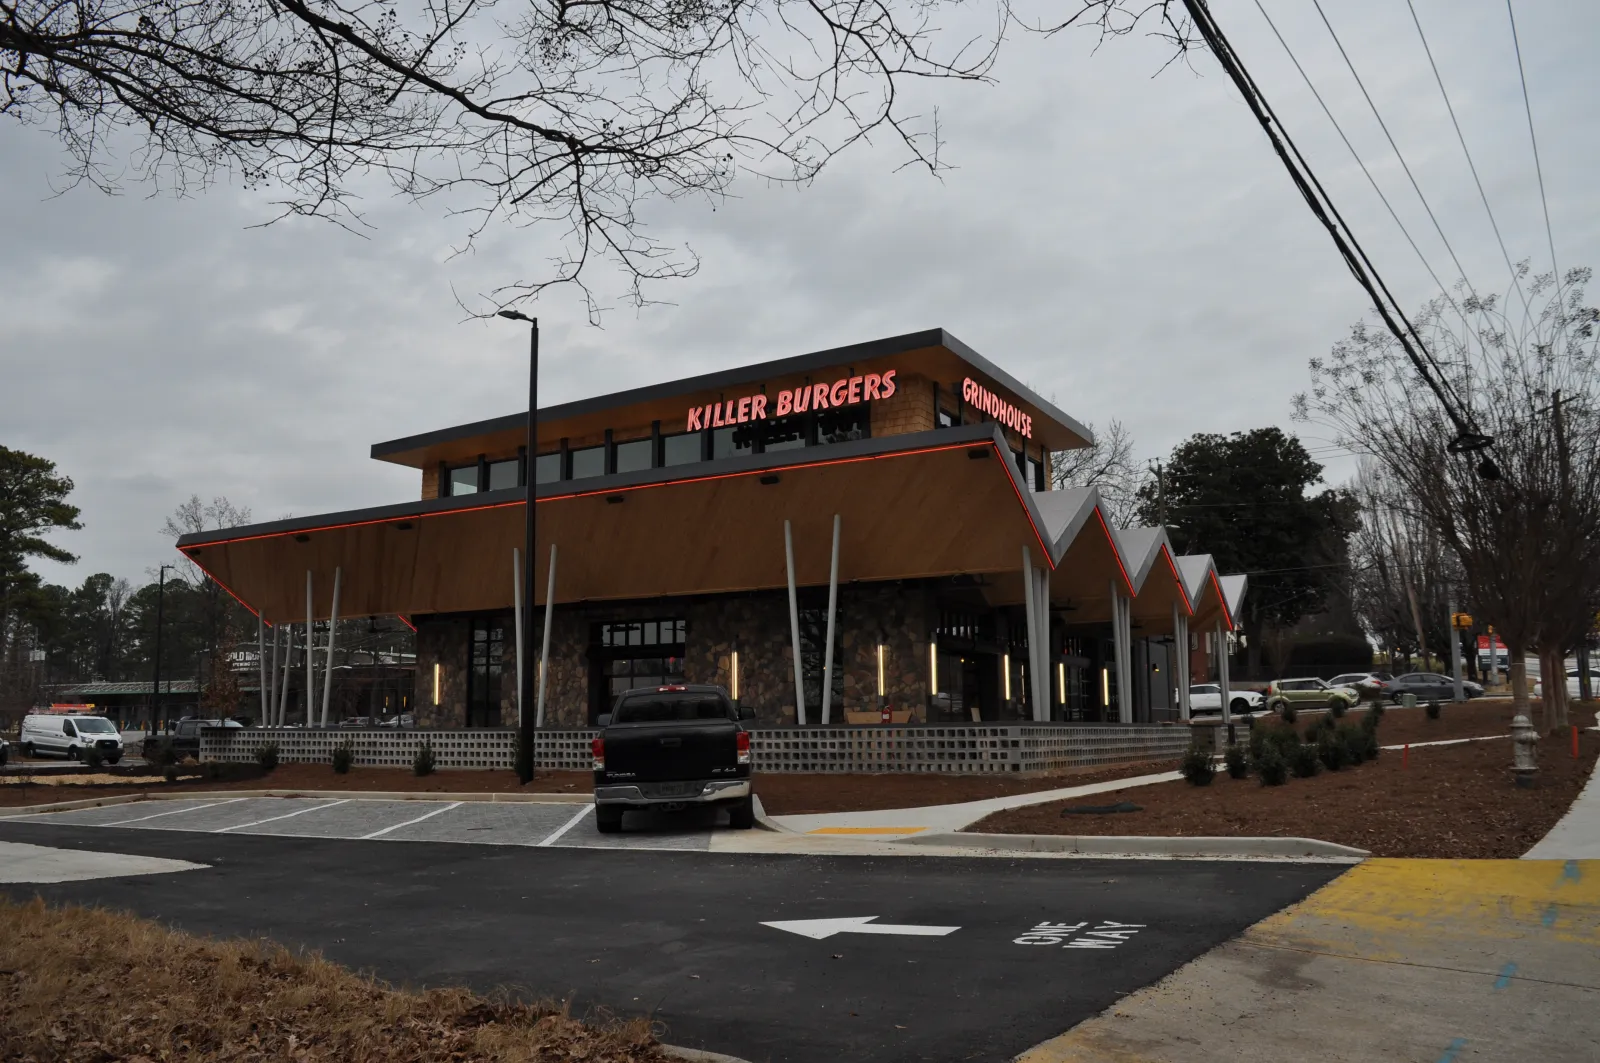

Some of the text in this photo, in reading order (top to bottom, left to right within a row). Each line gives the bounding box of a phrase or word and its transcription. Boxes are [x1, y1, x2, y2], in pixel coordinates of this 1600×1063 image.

[687, 369, 897, 432] KILLER BURGERS
[963, 377, 1032, 439] GRINDHOUSE
[1012, 921, 1089, 945] ONE
[1062, 920, 1147, 949] WAY
